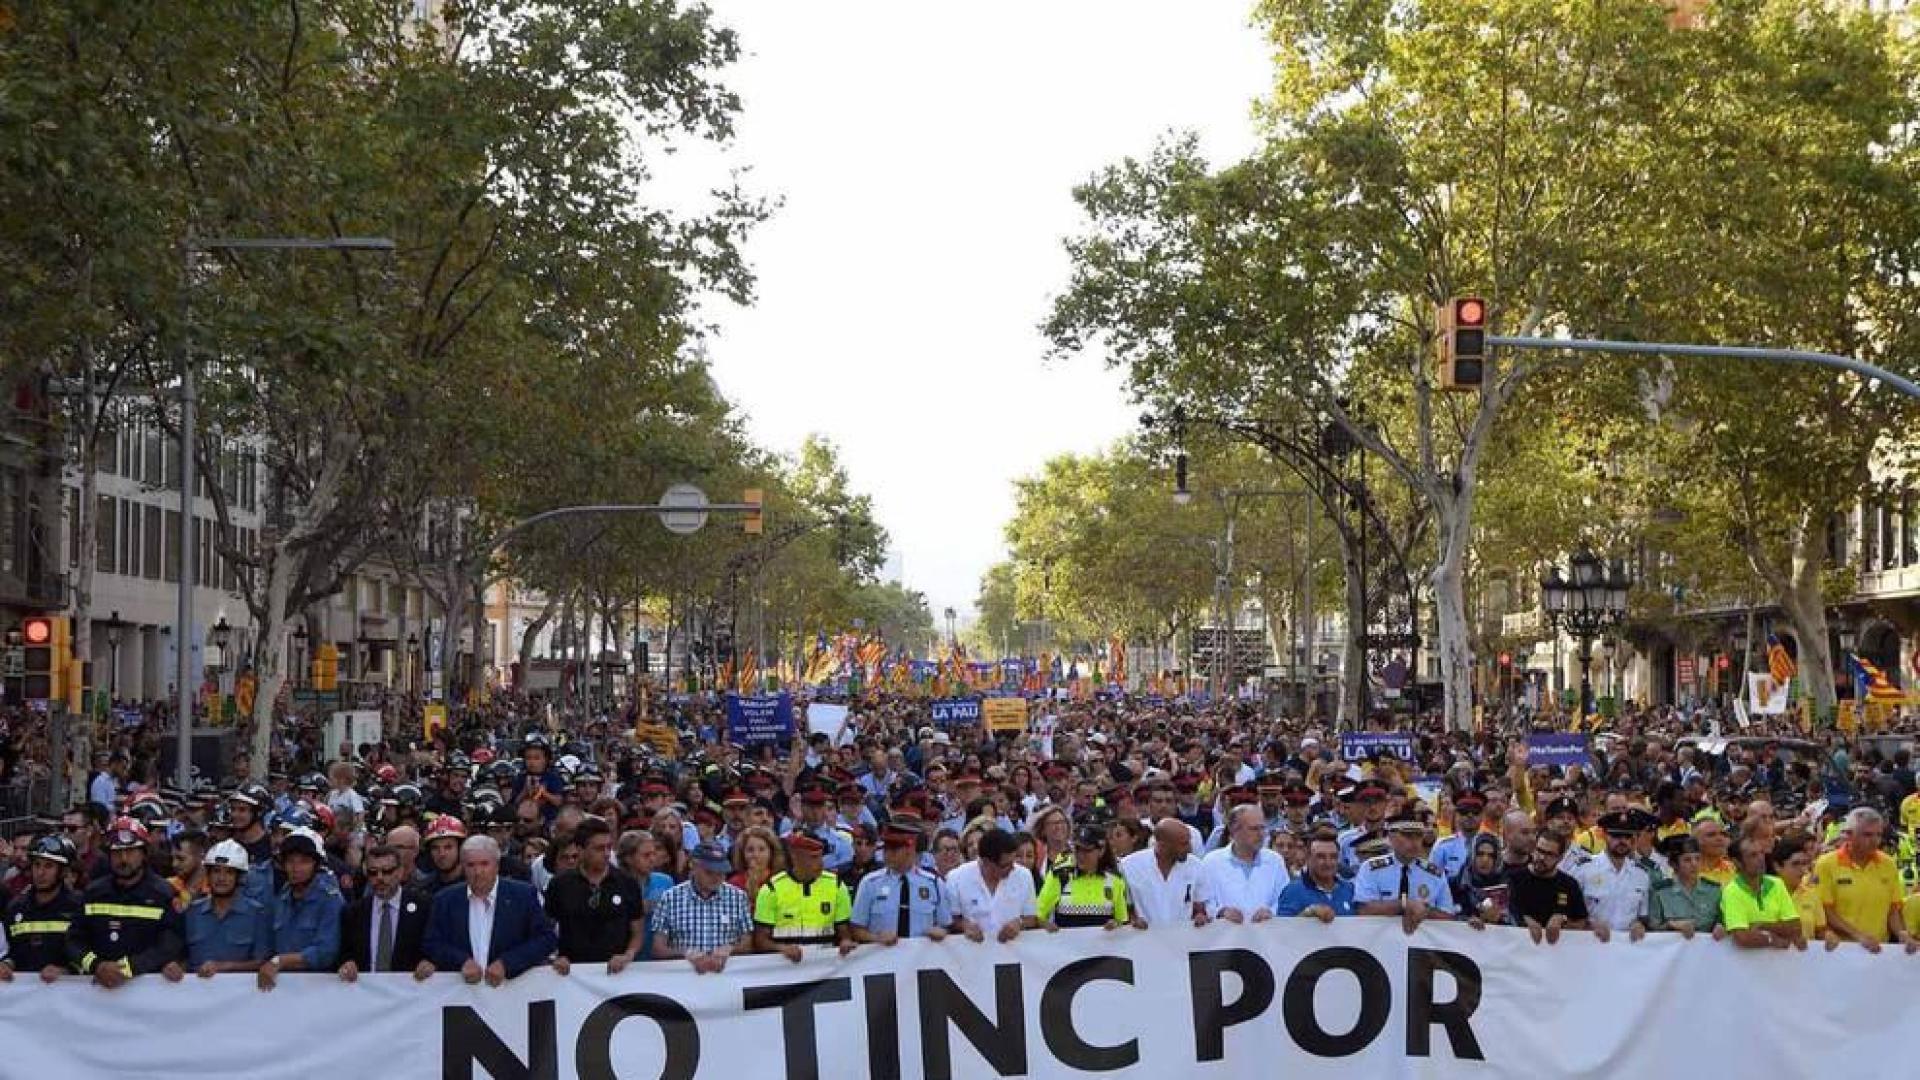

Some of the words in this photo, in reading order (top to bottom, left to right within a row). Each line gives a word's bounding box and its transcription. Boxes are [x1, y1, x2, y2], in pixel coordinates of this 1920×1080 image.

[932, 706, 949, 719] LA
[951, 705, 979, 718] PAU
[1343, 745, 1368, 760] LA
[442, 992, 701, 1080] NO
[742, 955, 1141, 1080] TINC
[1188, 945, 1485, 1063] POR
